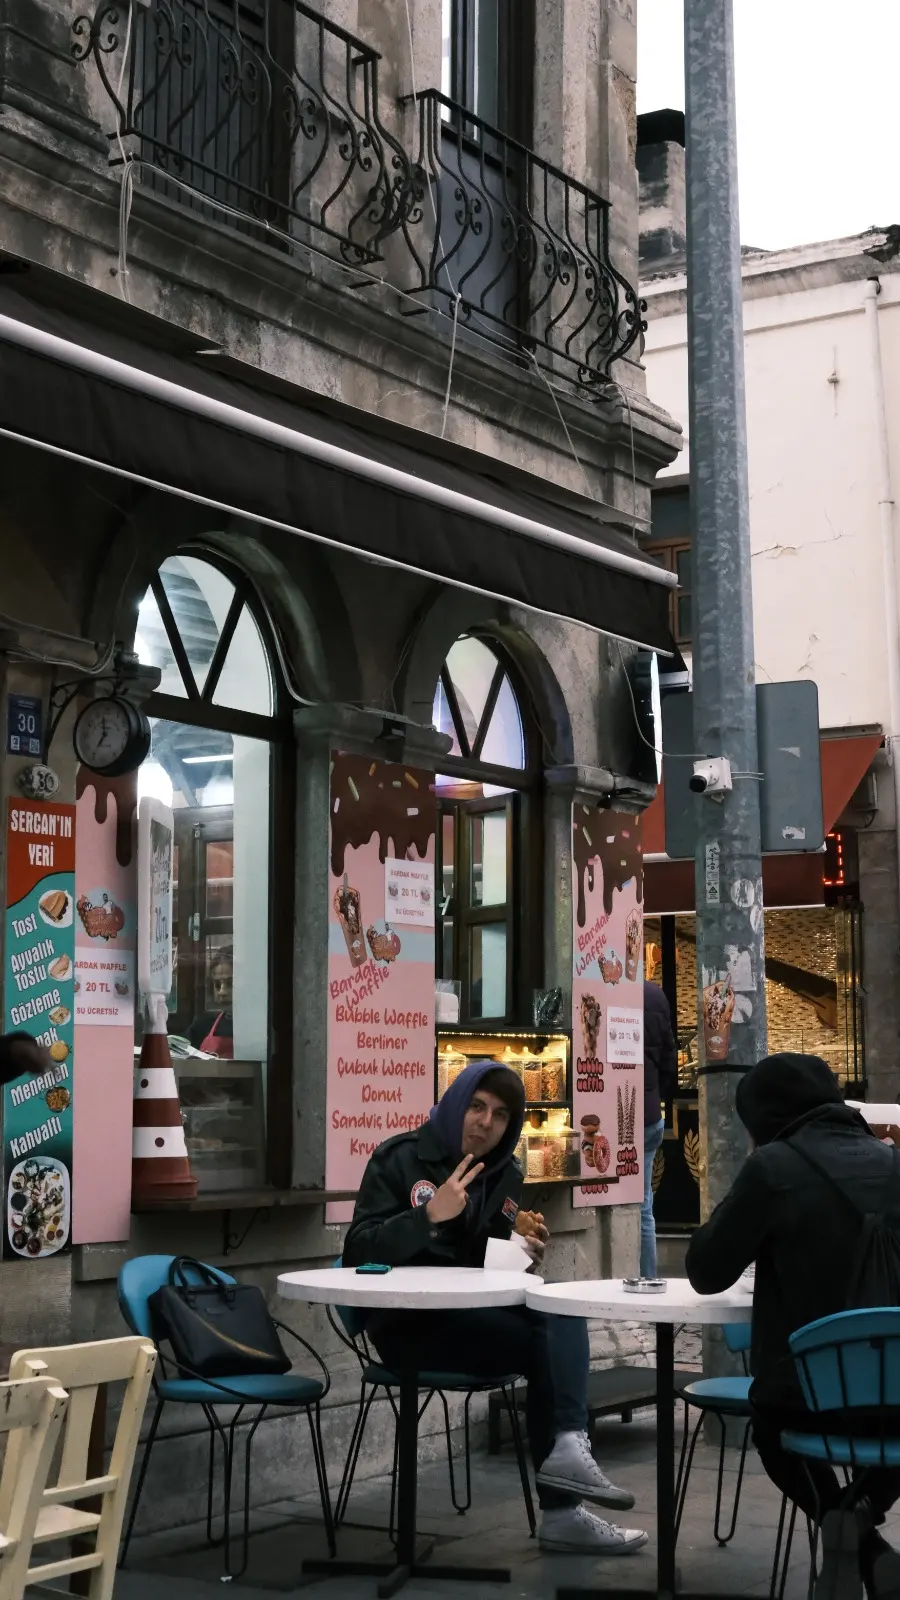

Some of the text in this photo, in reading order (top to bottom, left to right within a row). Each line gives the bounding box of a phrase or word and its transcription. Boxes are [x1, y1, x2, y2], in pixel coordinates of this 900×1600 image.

[18, 713, 35, 734] 30
[37, 771, 55, 793] 30
[10, 809, 72, 838] SERCAN'IN
[28, 840, 54, 867] YERİ
[401, 888, 419, 898] 20 TL
[12, 912, 38, 938] Tost
[577, 913, 611, 952] Bardak
[11, 938, 55, 973] Ayvalık
[74, 961, 127, 971] ARDAK WAFFLE
[576, 933, 607, 977] Waffle
[14, 964, 47, 992] Tostu
[85, 982, 111, 993] 20 TL
[329, 959, 377, 1000] Bardak
[345, 965, 390, 1010] Waffle
[10, 988, 62, 1027] Gözleme
[87, 1004, 119, 1016] ÜCRETSİZ
[335, 1004, 428, 1028] Bubble Waffle
[357, 1032, 408, 1050] Berliner
[337, 1057, 426, 1079] Çubuk Waffle
[10, 1063, 69, 1107] Menemen
[362, 1084, 403, 1103] Donut
[332, 1110, 382, 1130] Sandviç
[9, 1116, 62, 1159] Kahvaltı
